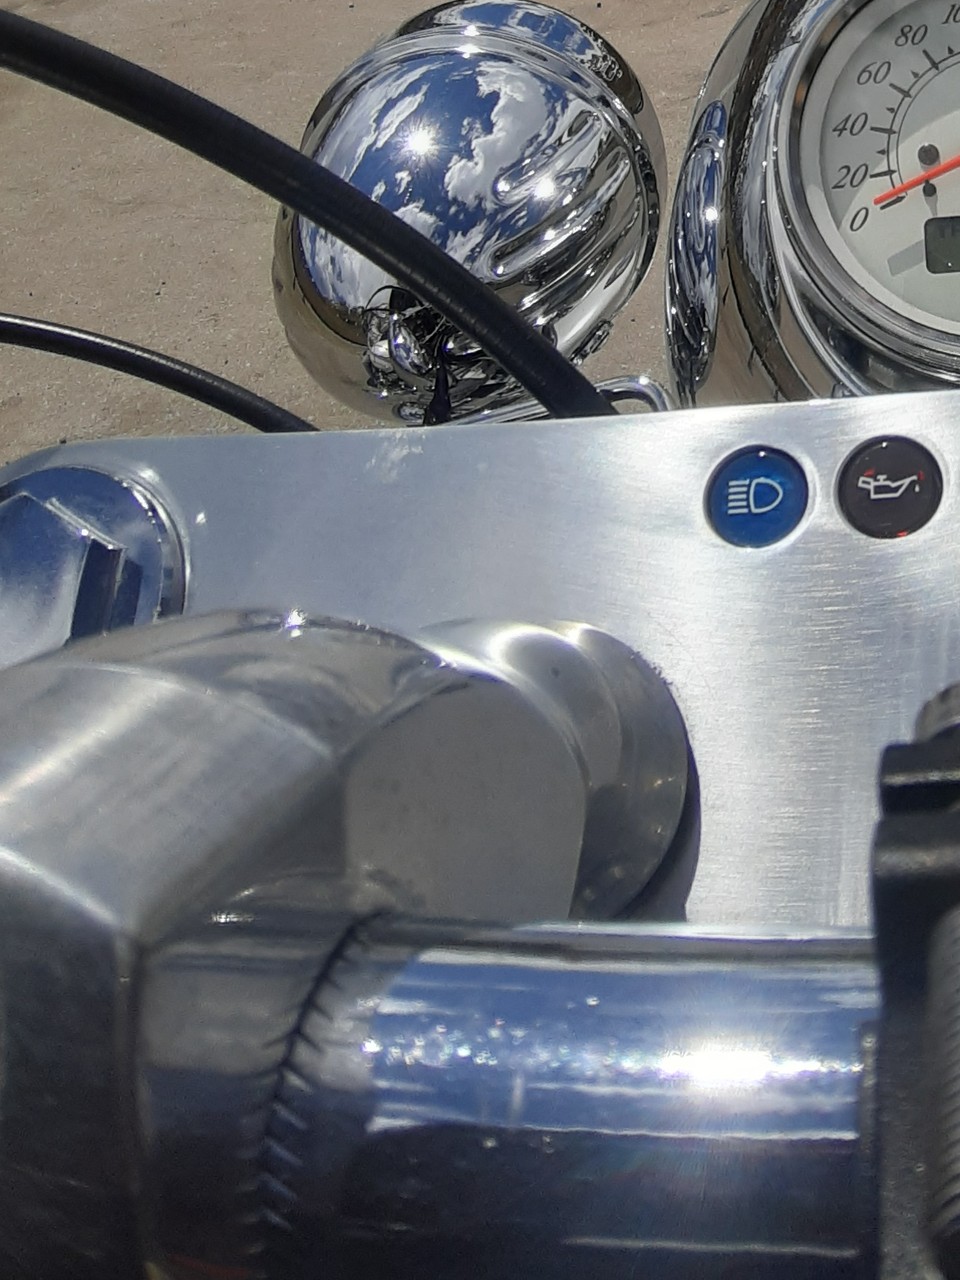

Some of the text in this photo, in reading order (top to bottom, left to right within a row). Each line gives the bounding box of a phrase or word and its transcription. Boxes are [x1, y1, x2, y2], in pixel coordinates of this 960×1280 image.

[894, 25, 928, 47] 80
[856, 60, 891, 85] 60
[832, 113, 868, 137] 40
[832, 164, 869, 190] 20
[849, 207, 869, 232] 0
